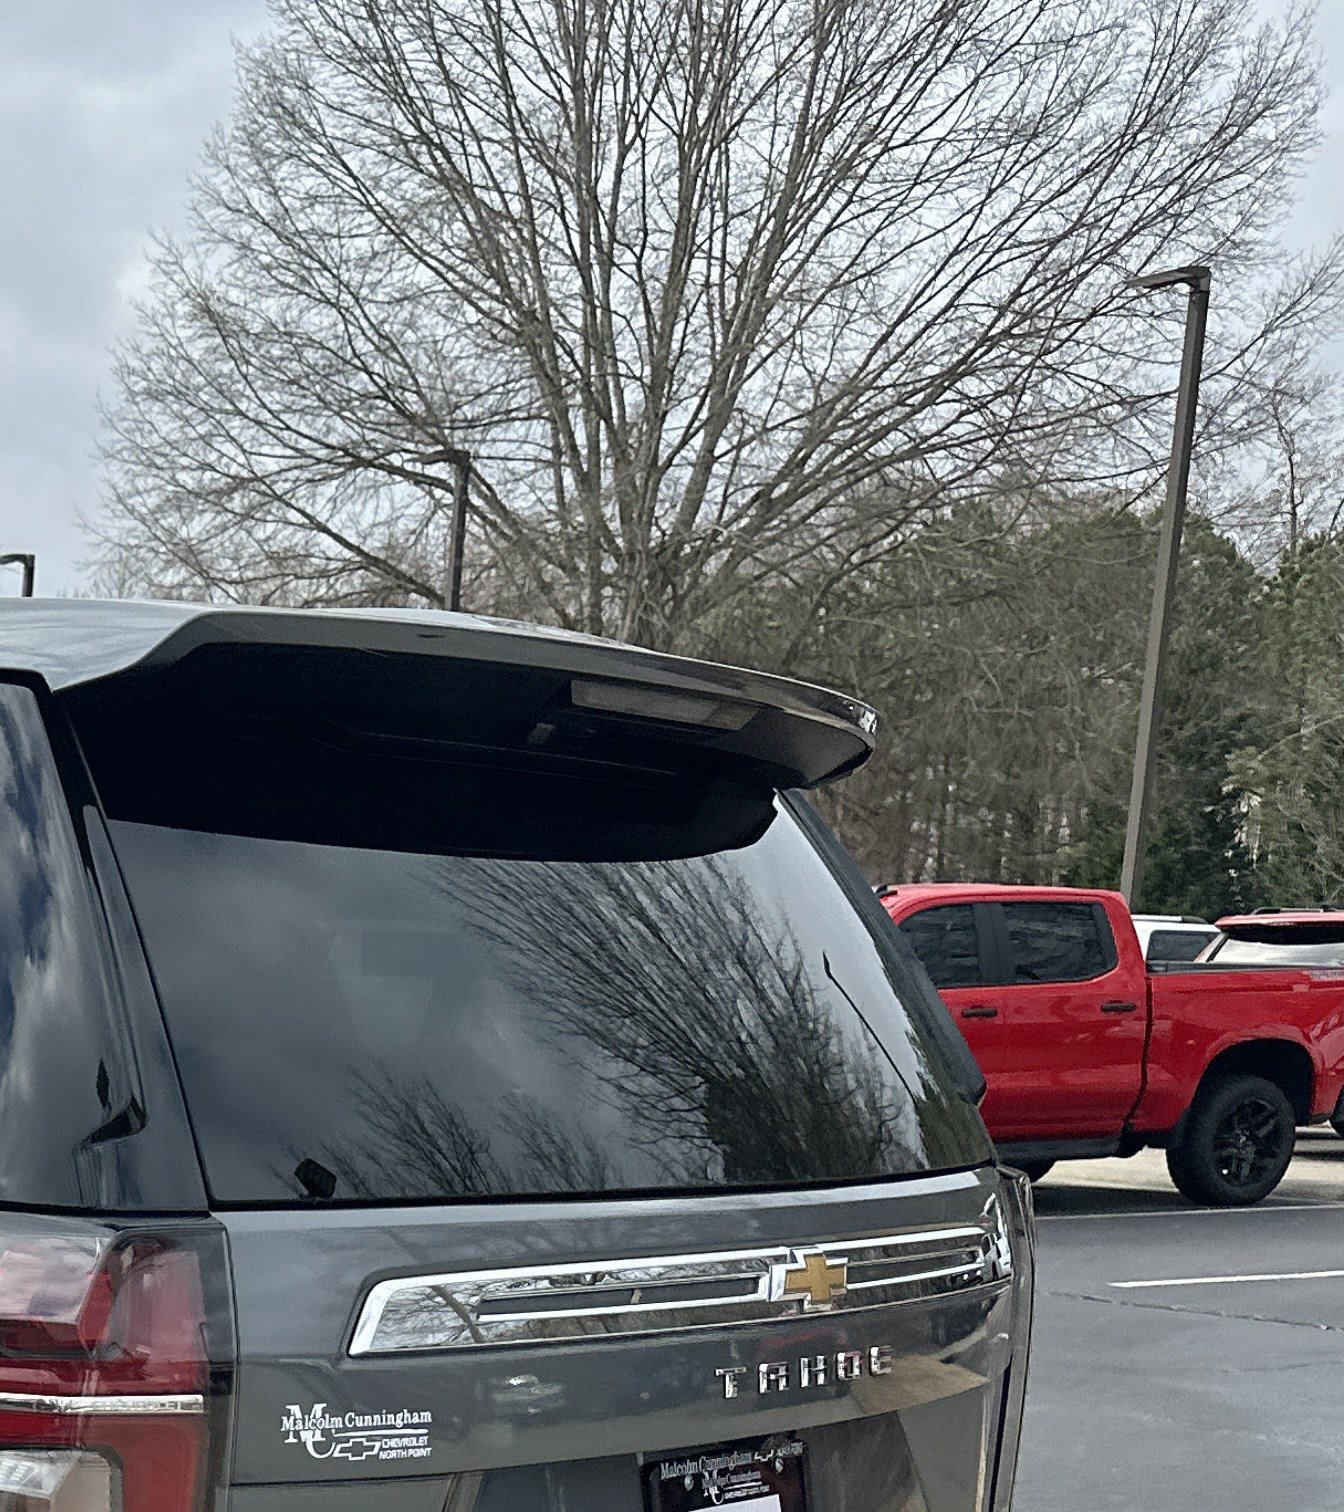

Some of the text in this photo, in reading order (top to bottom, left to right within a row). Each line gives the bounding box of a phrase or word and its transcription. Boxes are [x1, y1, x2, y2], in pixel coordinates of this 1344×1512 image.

[715, 1345, 894, 1399] TAHOE
[280, 1408, 432, 1432] Malcolm Cunningham
[381, 1435, 428, 1449] CHEVROLET
[378, 1447, 432, 1460] NORTH POINT
